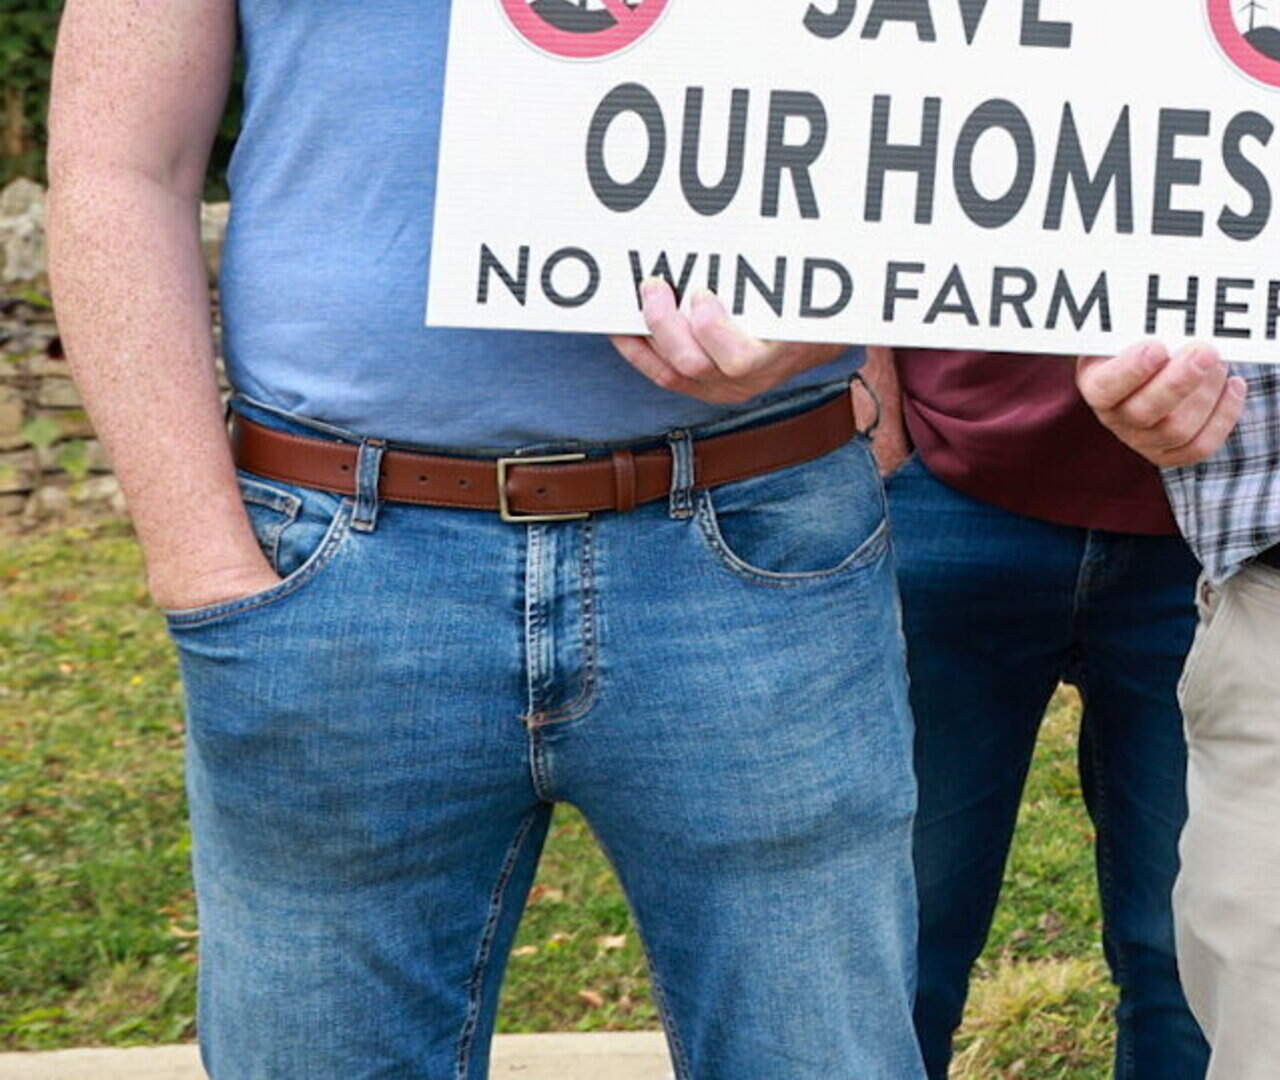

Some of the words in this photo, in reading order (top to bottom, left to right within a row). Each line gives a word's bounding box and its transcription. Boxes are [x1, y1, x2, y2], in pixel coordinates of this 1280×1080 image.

[585, 82, 828, 219] OUR
[863, 94, 1275, 242] HOMES
[476, 243, 600, 308] NO
[628, 250, 854, 319] WIND
[882, 261, 1112, 333] FARM
